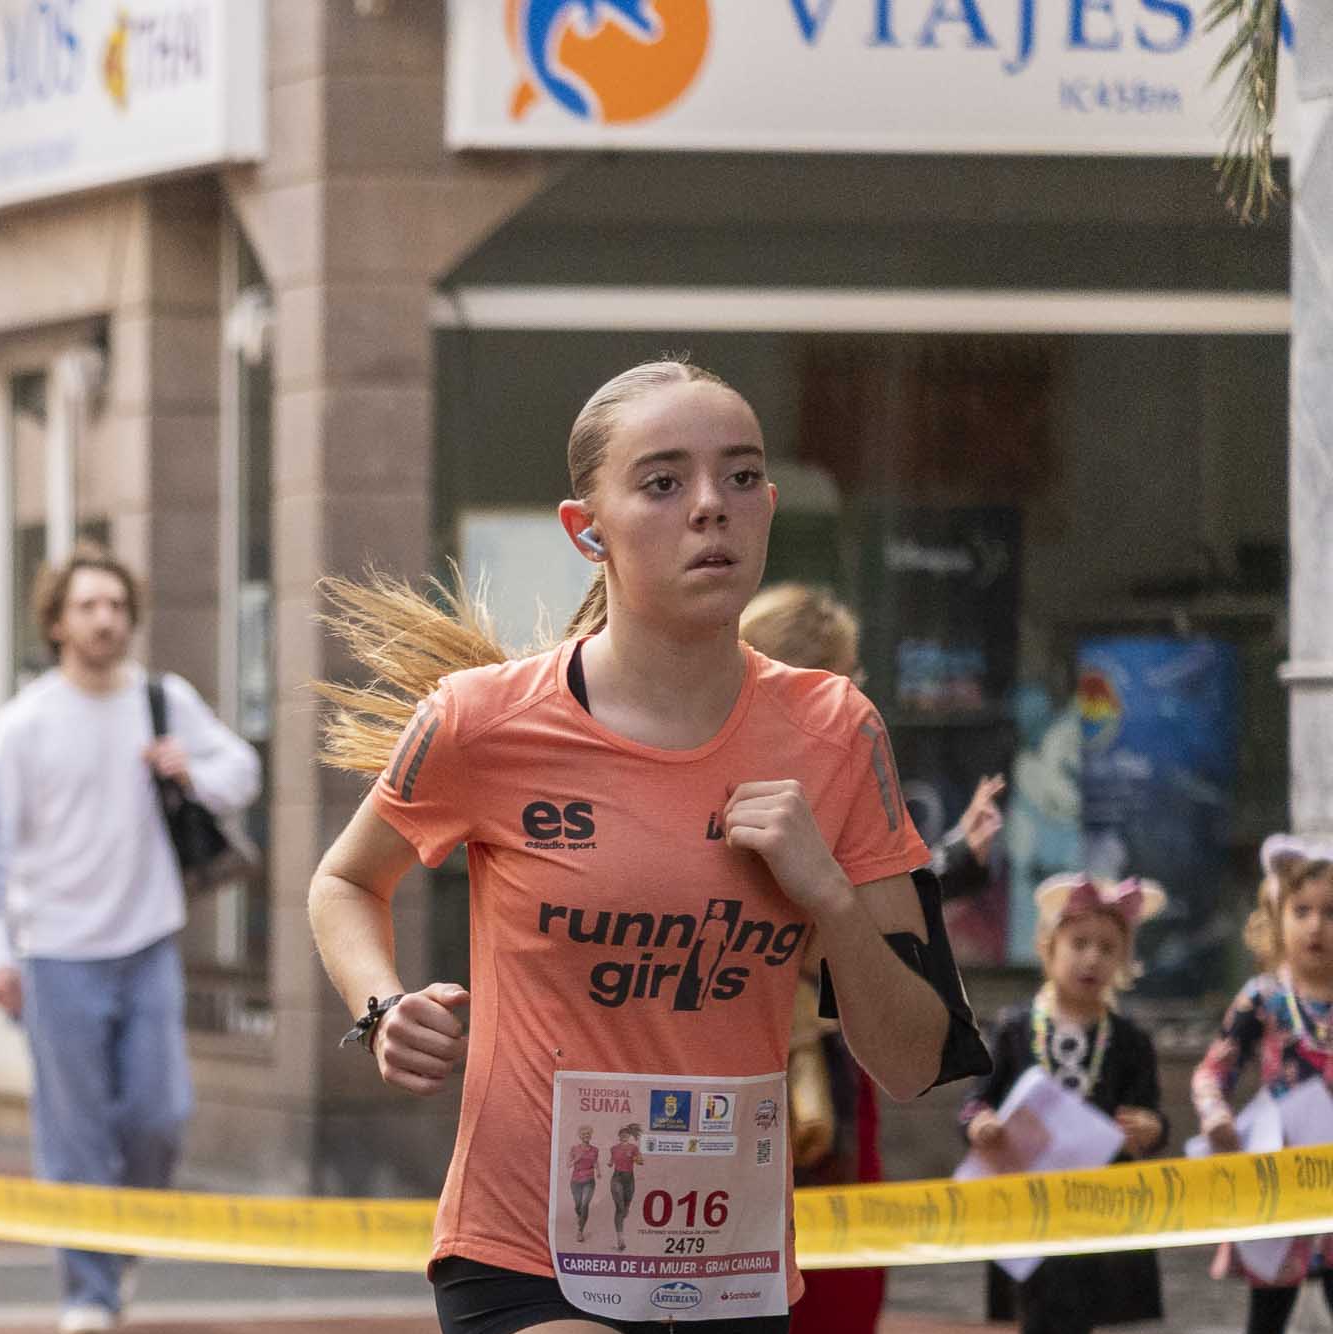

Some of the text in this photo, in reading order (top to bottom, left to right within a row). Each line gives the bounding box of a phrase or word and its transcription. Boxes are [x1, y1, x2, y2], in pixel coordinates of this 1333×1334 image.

[522, 800, 596, 841] es
[524, 841, 566, 850] estadio
[578, 1087, 632, 1099] TU DORSAL
[580, 1098, 632, 1114] SUMA
[642, 1189, 730, 1229] 016
[664, 1237, 705, 1255] 2479
[563, 1255, 773, 1275] CARRERA DE LA MUJER GRAN CANARIA
[583, 1290, 622, 1306] OYSHO
